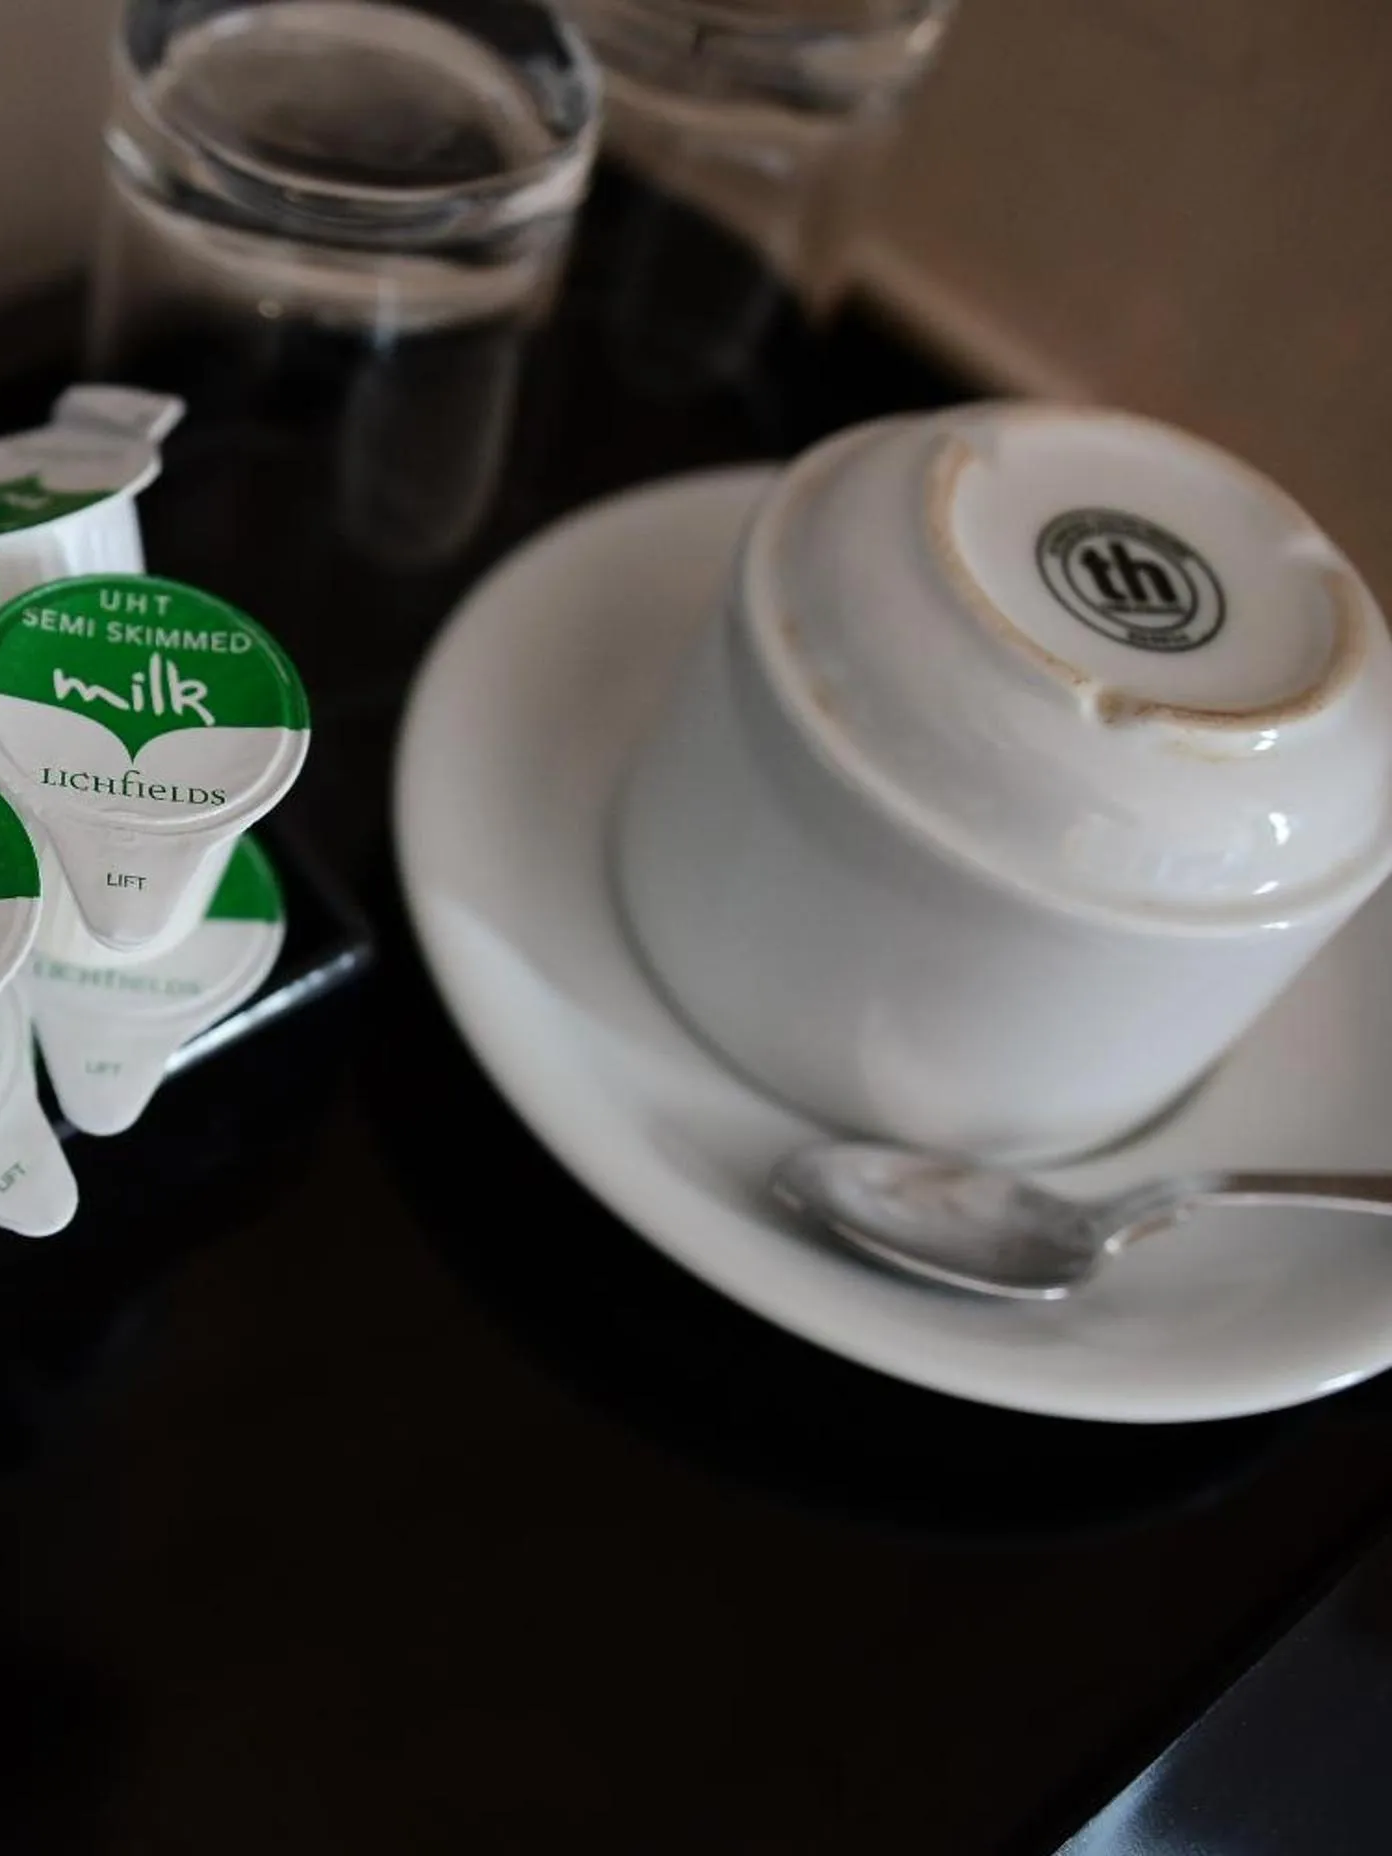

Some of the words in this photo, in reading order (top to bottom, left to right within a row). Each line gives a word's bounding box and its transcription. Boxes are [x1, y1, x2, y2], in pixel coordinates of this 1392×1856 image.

[1080, 538, 1178, 604] th
[100, 589, 171, 615] UHT
[22, 608, 96, 638] SEMI
[107, 622, 252, 654] SKIMMED
[53, 651, 215, 726] milk
[107, 873, 147, 891] LIFT
[85, 1060, 122, 1077] LIFT
